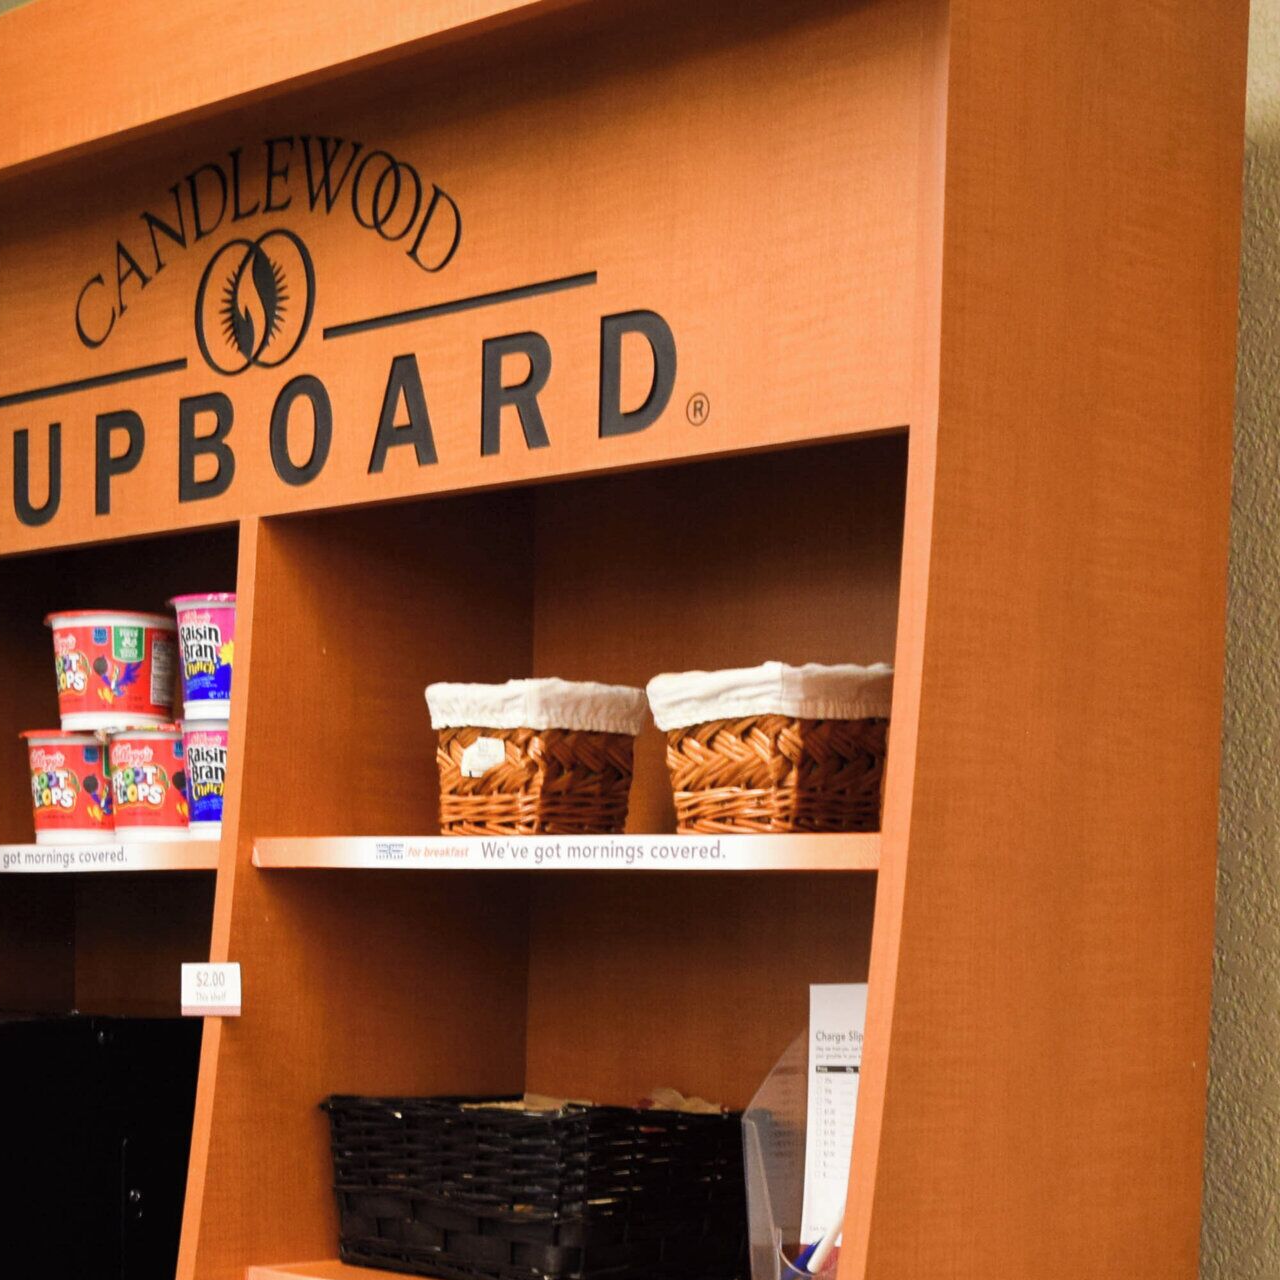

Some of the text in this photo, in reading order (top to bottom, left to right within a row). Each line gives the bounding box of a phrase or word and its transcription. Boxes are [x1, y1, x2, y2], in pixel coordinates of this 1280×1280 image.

[74, 134, 462, 349] CANDLEWOOD
[181, 625, 219, 643] Raisin
[184, 643, 216, 659] Bran
[3, 852, 21, 868] got
[25, 848, 76, 868] mornings
[79, 847, 128, 863] covered.
[408, 840, 726, 864] for breakfast We've got mornings covered.
[196, 971, 226, 987] $2.00
[816, 1031, 846, 1043] Charge
